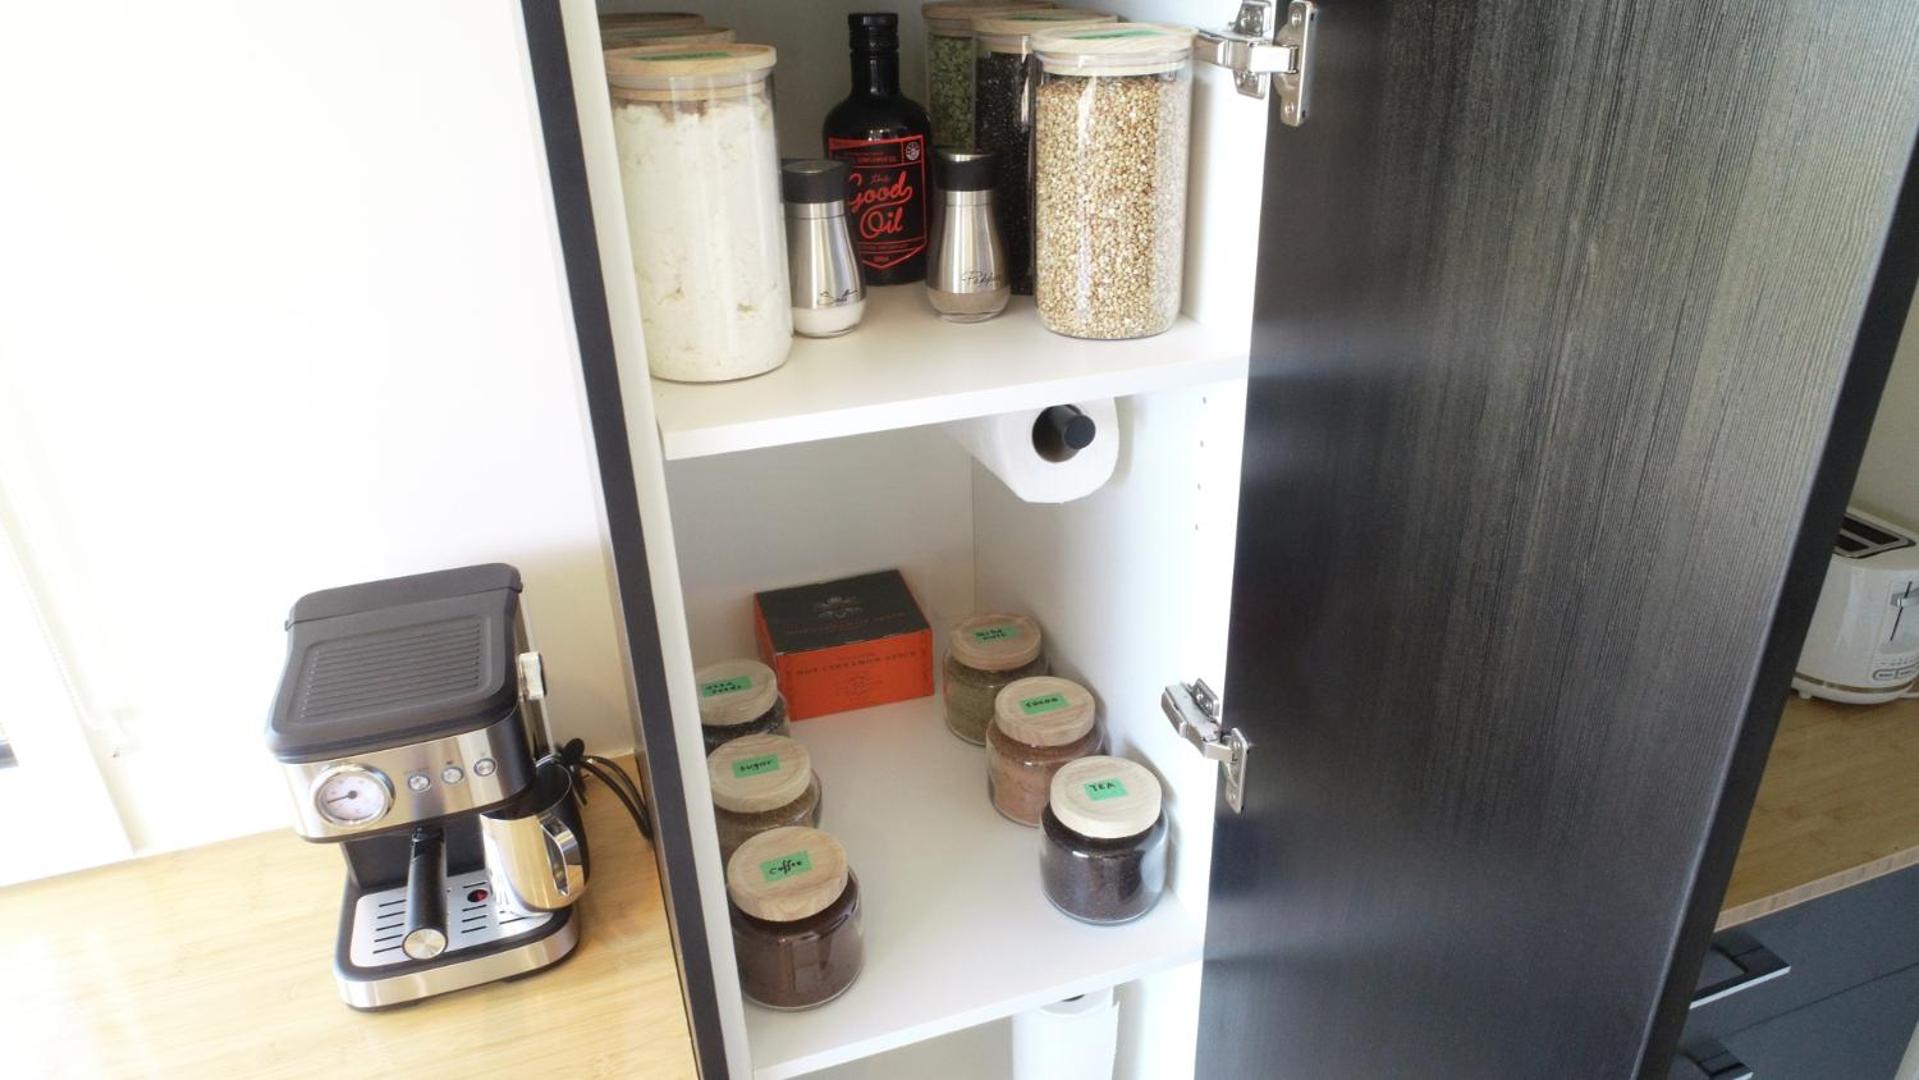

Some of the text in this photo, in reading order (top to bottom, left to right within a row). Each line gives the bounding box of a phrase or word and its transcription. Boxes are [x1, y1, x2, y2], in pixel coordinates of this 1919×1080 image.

[849, 170, 913, 213] Good
[861, 206, 904, 239] Oil
[1088, 781, 1116, 792] TEA
